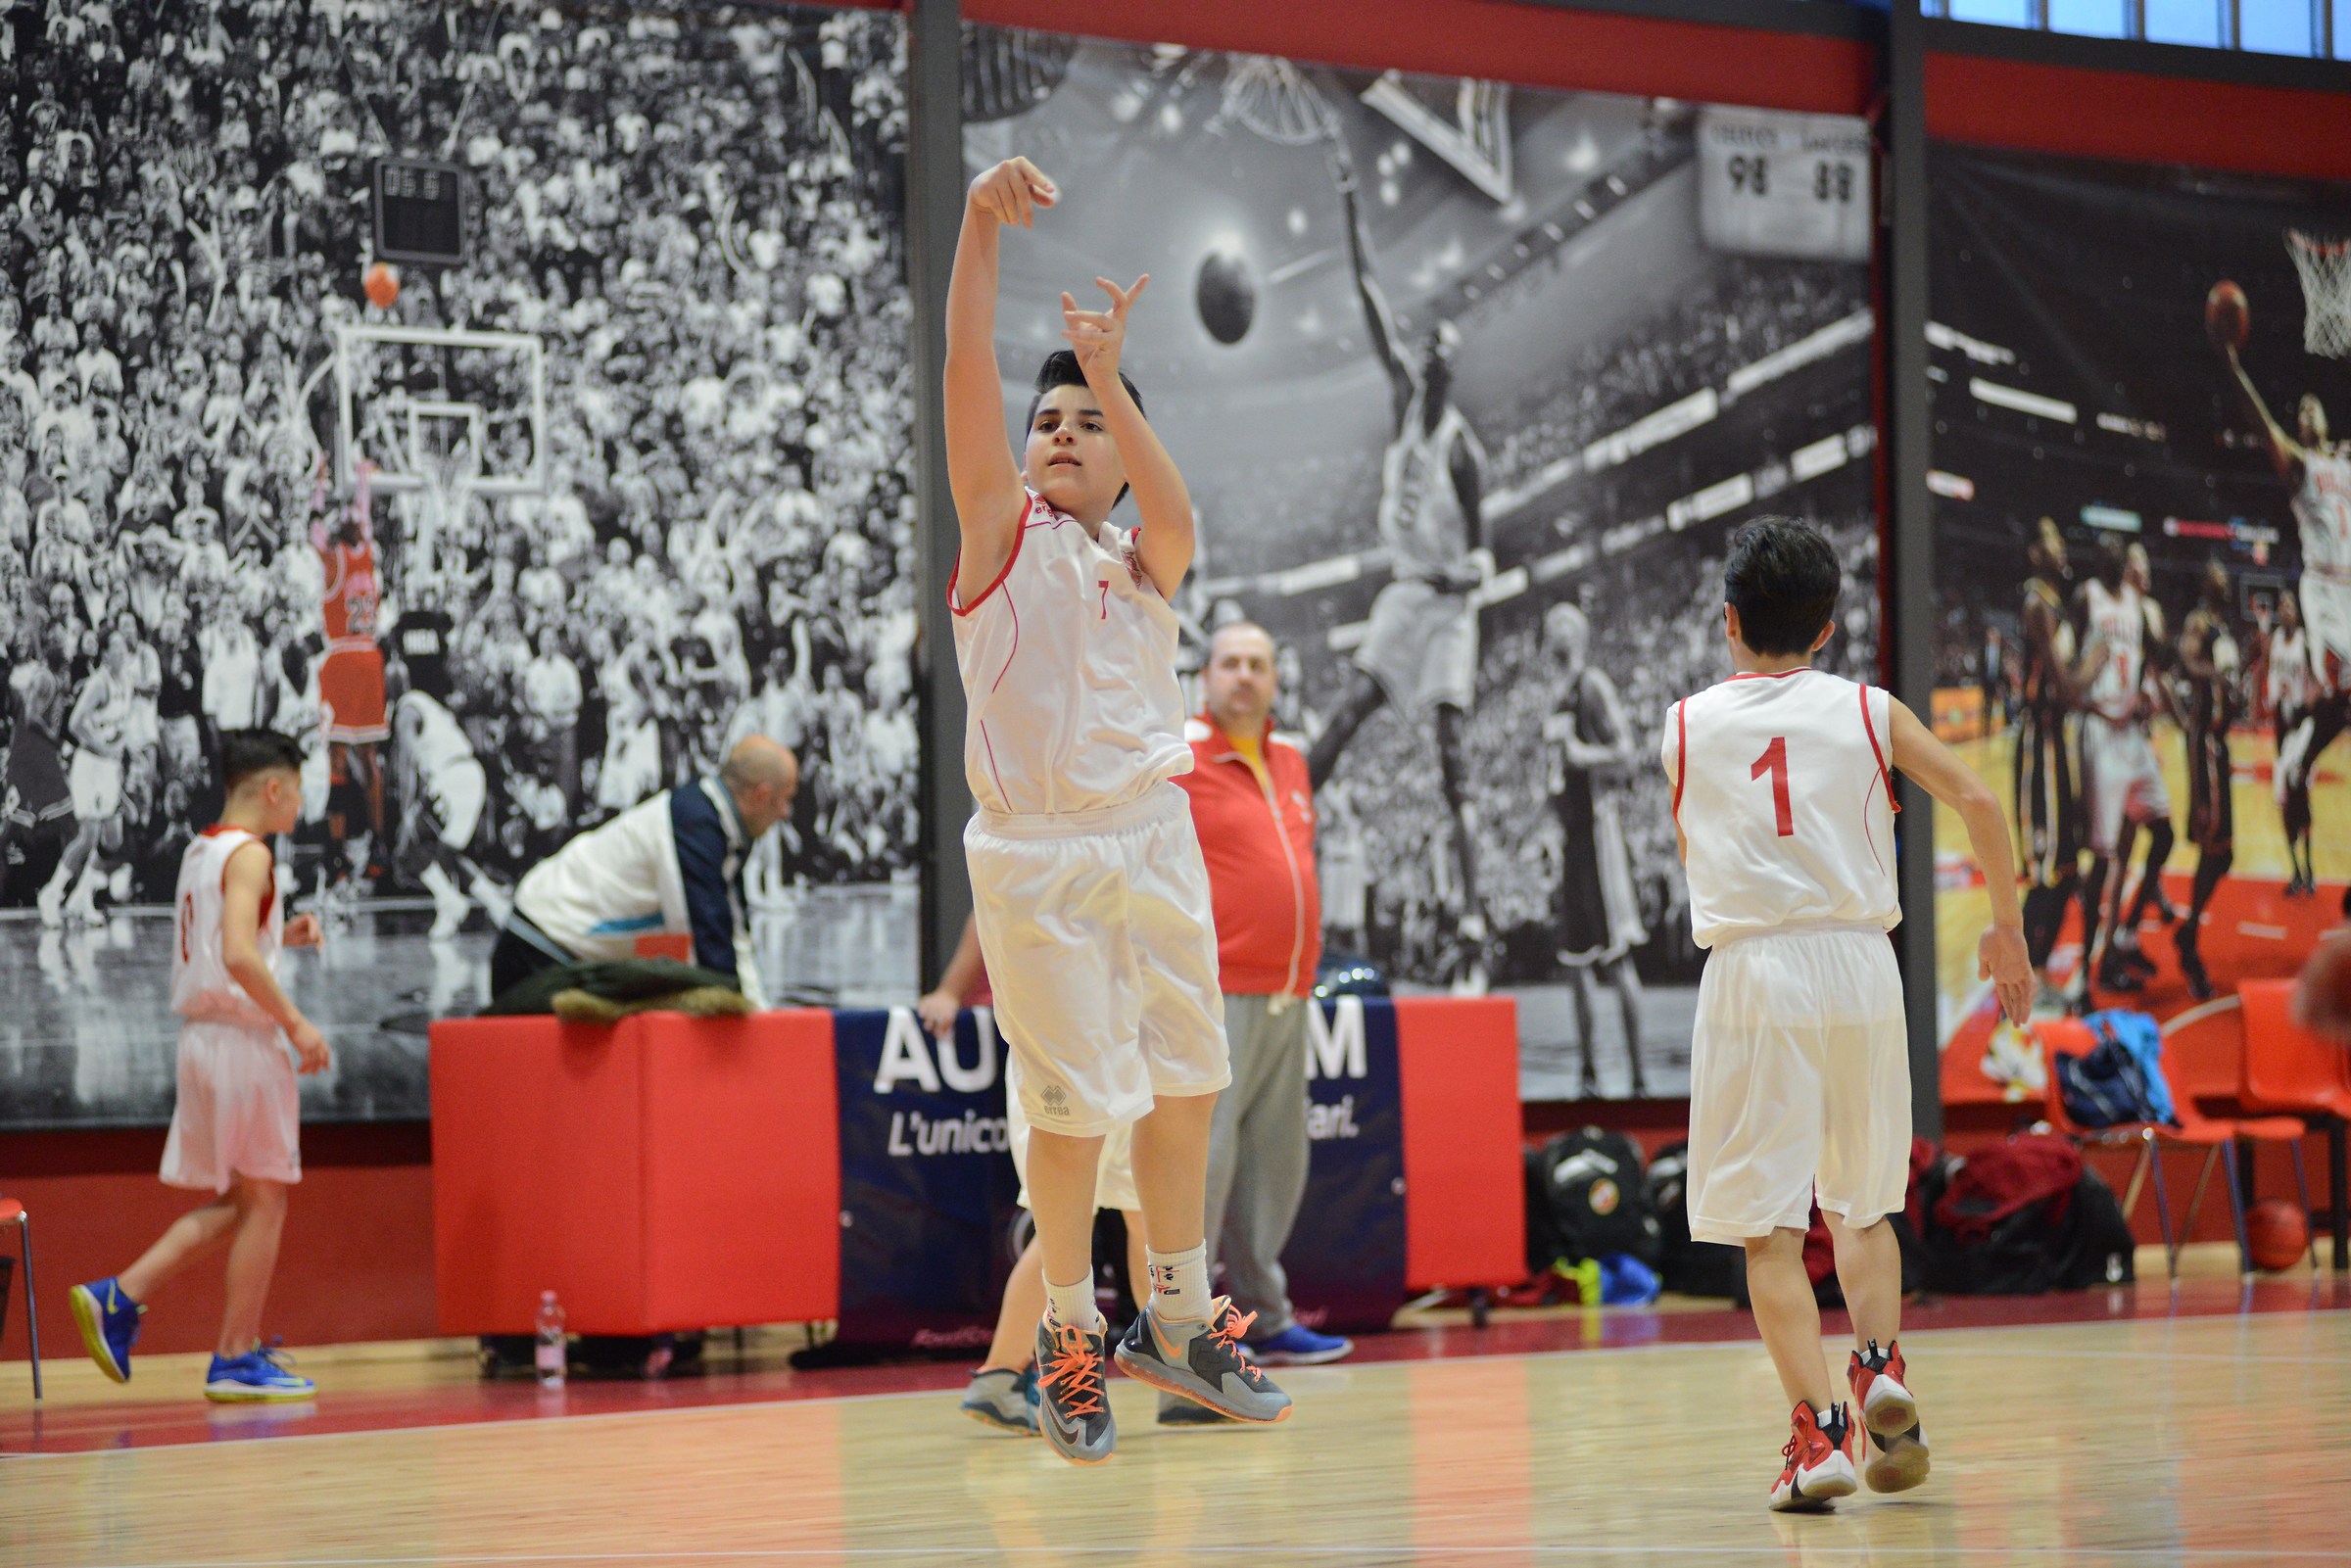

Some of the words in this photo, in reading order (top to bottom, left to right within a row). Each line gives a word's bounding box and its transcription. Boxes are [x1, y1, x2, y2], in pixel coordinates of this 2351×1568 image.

[1098, 580, 1109, 619] 7
[1750, 736, 1794, 837] 1
[873, 1004, 999, 1094] AU
[1305, 993, 1368, 1079] M
